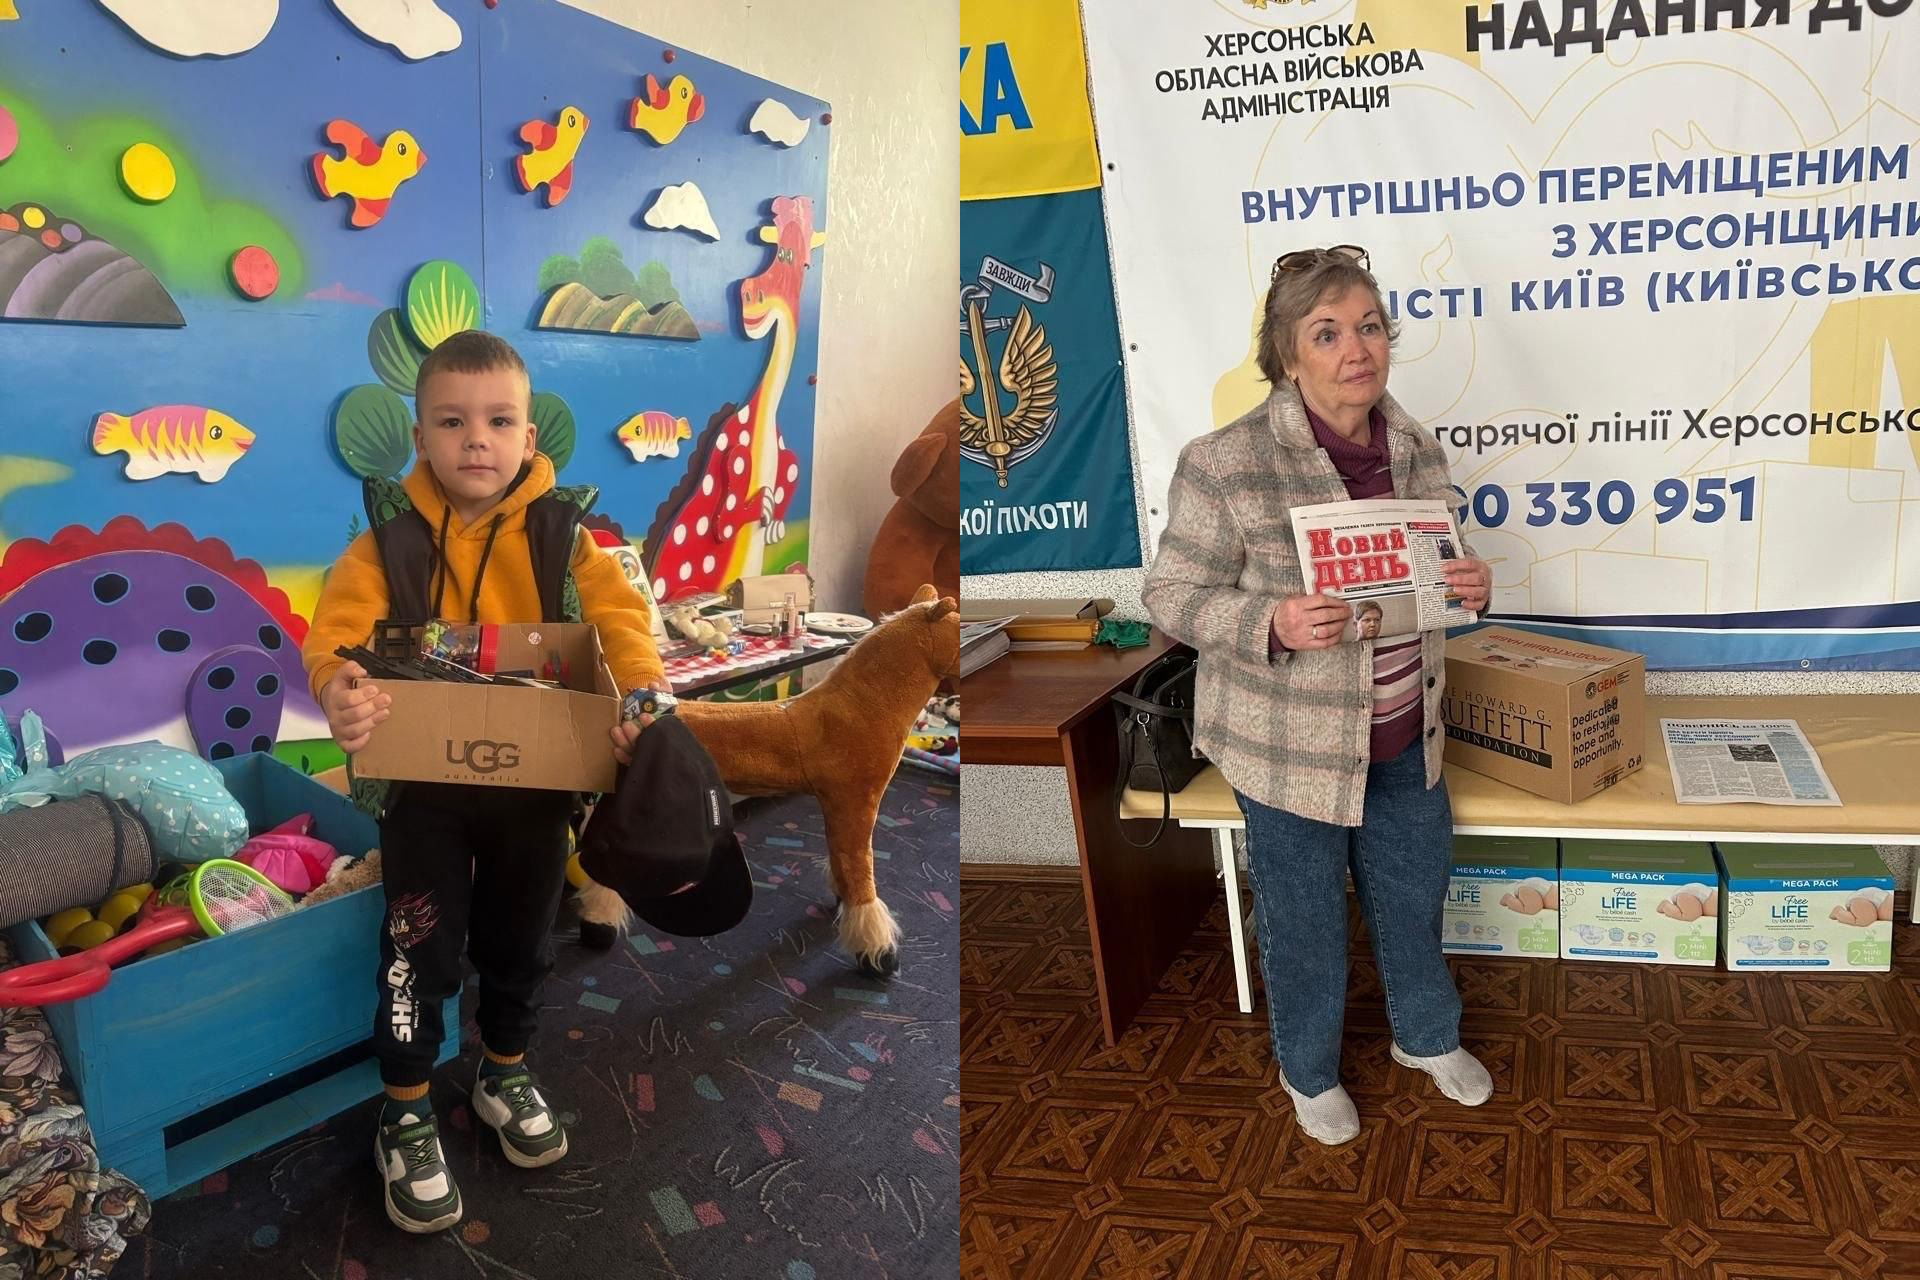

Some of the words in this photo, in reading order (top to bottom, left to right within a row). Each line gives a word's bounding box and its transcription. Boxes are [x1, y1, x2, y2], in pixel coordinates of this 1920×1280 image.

[1204, 22, 1375, 58] ХЕРСОНСЬКА
[1465, 0, 1790, 57] НАДАННЯ
[1155, 62, 1278, 93] ОБЛАСНА
[1284, 48, 1424, 83] ВІЙСЬКОВА
[1201, 85, 1391, 123] АДМІНІСТРАЦІЯ
[1242, 172, 1525, 223] ВНУТРІШНЬО
[1539, 144, 1909, 205] ПЕРЕМІЩЕНИМ
[1552, 224, 1577, 258] З
[986, 261, 1031, 292] ЗАВЖДИ
[1511, 269, 1625, 312] КИЇВ
[1647, 257, 1920, 312] (КИЇВСЬКО
[1435, 412, 1576, 455] гарячої
[1588, 409, 1672, 443] лінії
[1681, 408, 1920, 446] Херсонсько
[1525, 479, 1635, 528] 330
[1653, 476, 1756, 524] 951
[997, 501, 1087, 534] ПІХОТИ
[1313, 553, 1410, 594] ДЕНЬ
[1597, 676, 1617, 693] GEM
[1465, 690, 1527, 715] HOWARD
[1572, 730, 1582, 742] to
[1573, 738, 1596, 756] hope
[1598, 727, 1615, 744] and
[447, 739, 521, 774] UGG
[1573, 739, 1624, 769] opportunity.
[445, 774, 519, 782] australia
[1611, 872, 1637, 880] MEGA
[1640, 873, 1665, 881] PACK
[1783, 880, 1810, 888] MEGA
[1813, 879, 1839, 887] PACK
[1448, 890, 1481, 902] LIFE
[1602, 897, 1637, 910] LIFE
[1613, 887, 1637, 897] Free
[1784, 895, 1808, 905] Free
[1772, 905, 1808, 918] LIFE
[1521, 936, 1531, 950] 2
[1679, 943, 1689, 957] 2
[1850, 949, 1861, 965] 2
